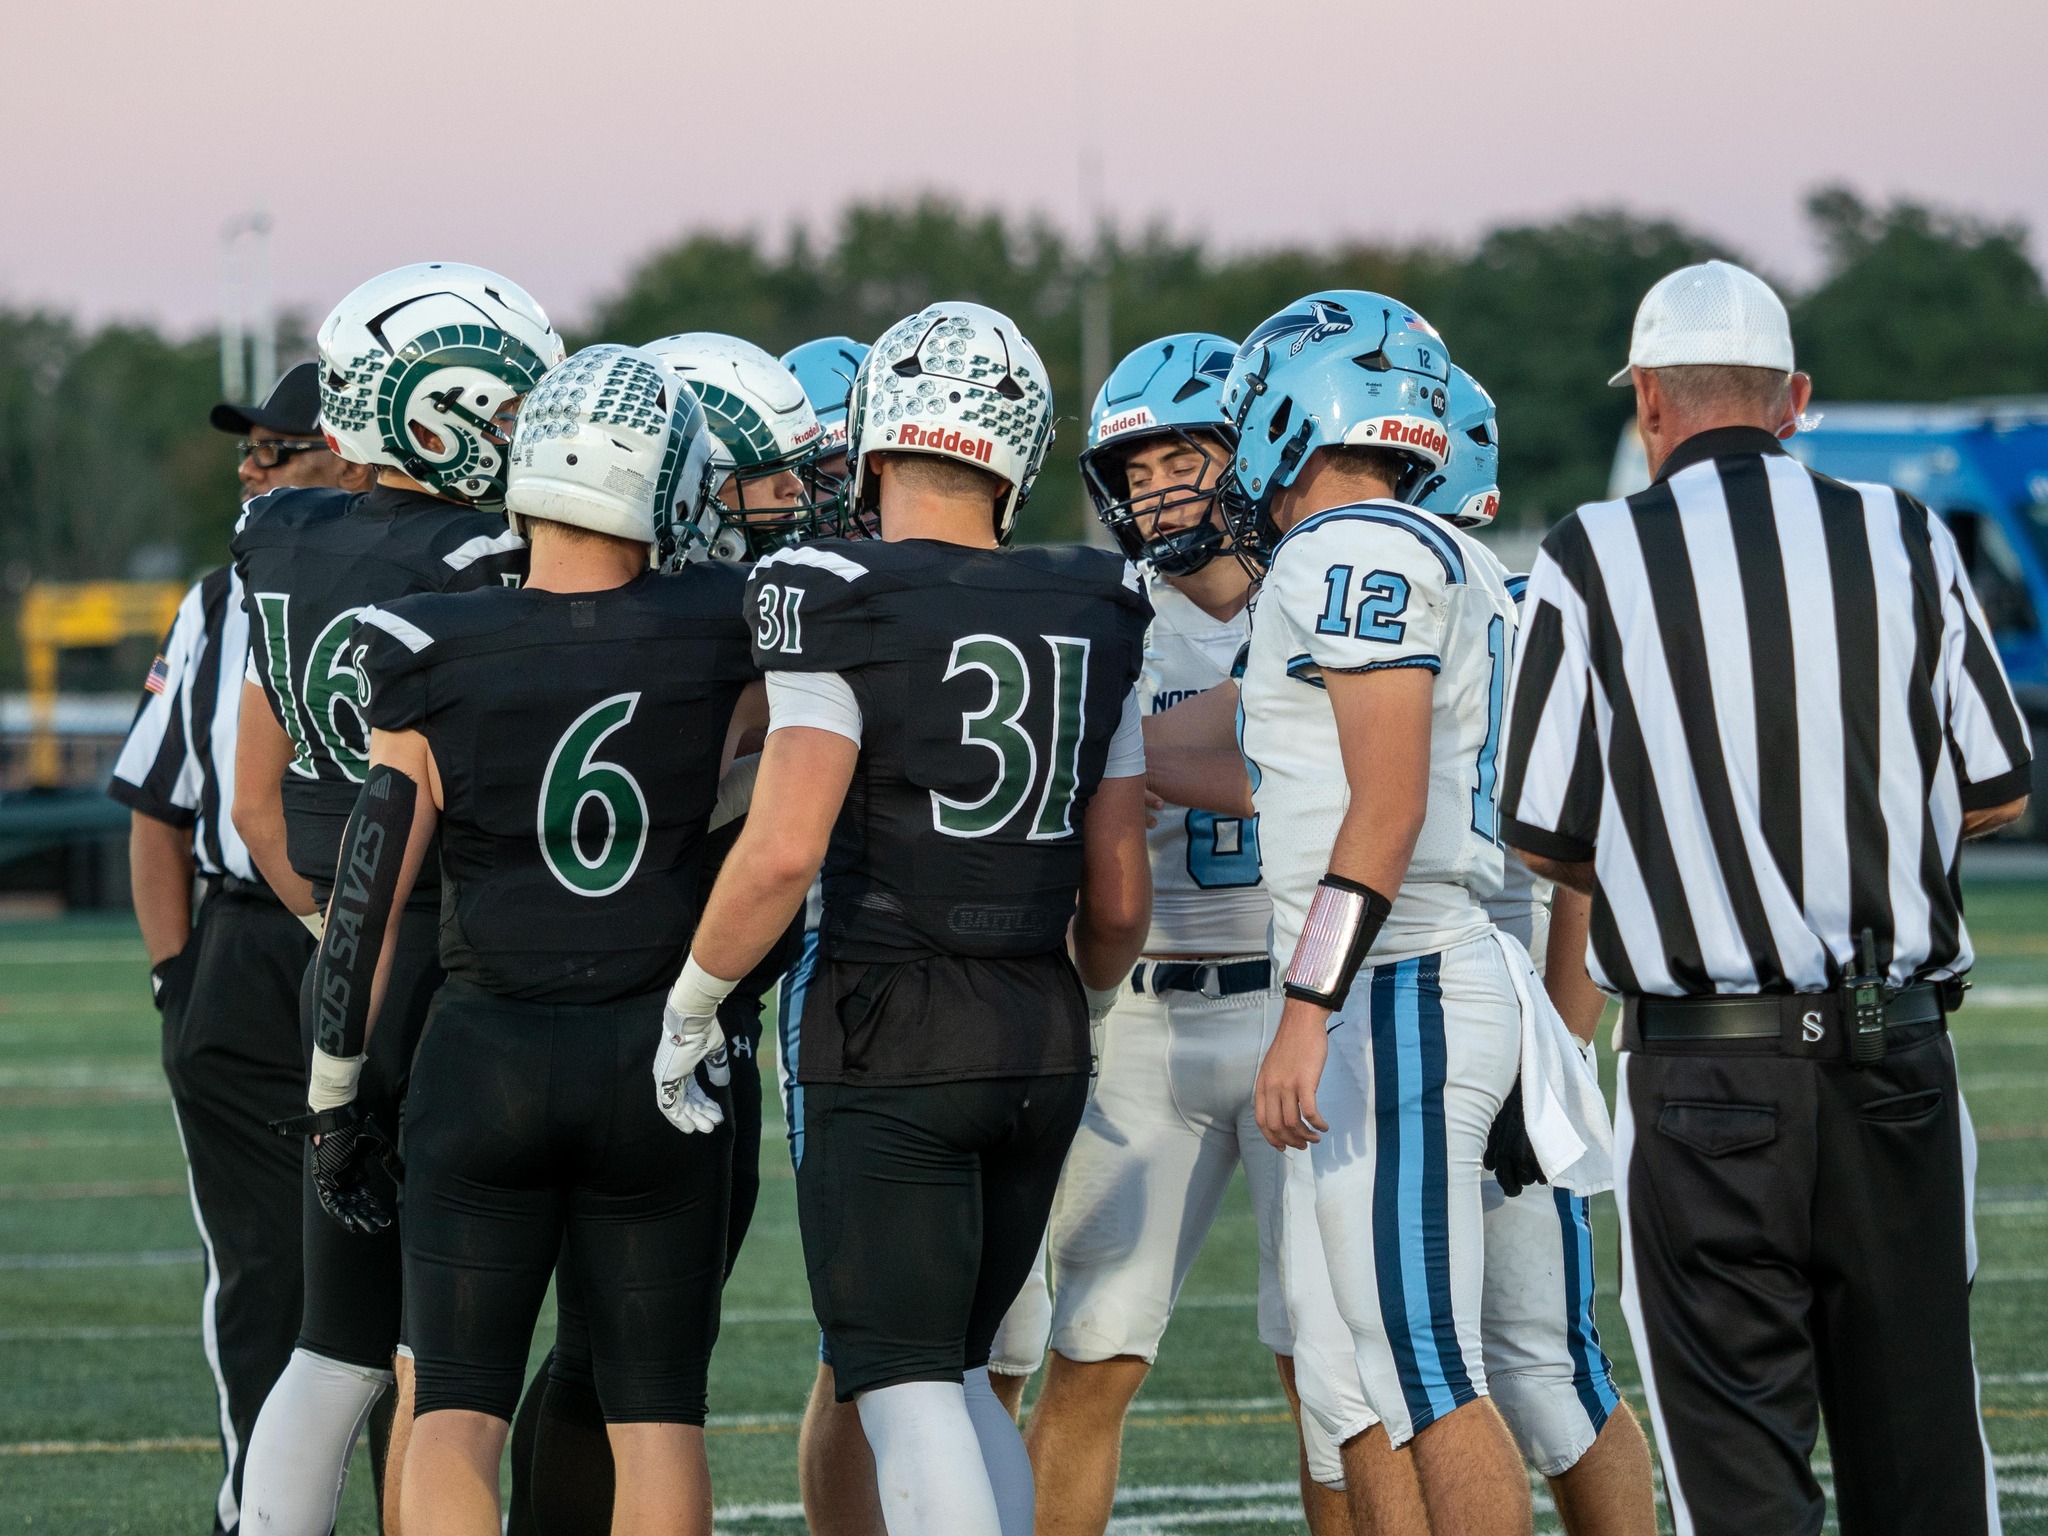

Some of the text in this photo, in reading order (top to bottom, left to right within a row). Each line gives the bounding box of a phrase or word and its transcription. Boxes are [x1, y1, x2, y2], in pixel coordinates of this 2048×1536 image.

[1417, 348, 1432, 369] 12
[1100, 412, 1147, 437] Riddell
[1433, 395, 1445, 411] DOC
[898, 424, 993, 464] Riddell
[757, 583, 806, 654] 31
[1315, 564, 1412, 645] 12
[253, 592, 371, 784] 16
[352, 644, 372, 708] 6
[929, 633, 1091, 841] 31
[1471, 612, 1510, 847] 1
[537, 691, 650, 898] 6
[328, 815, 386, 972] SAVES
[1802, 1010, 1825, 1042] S
